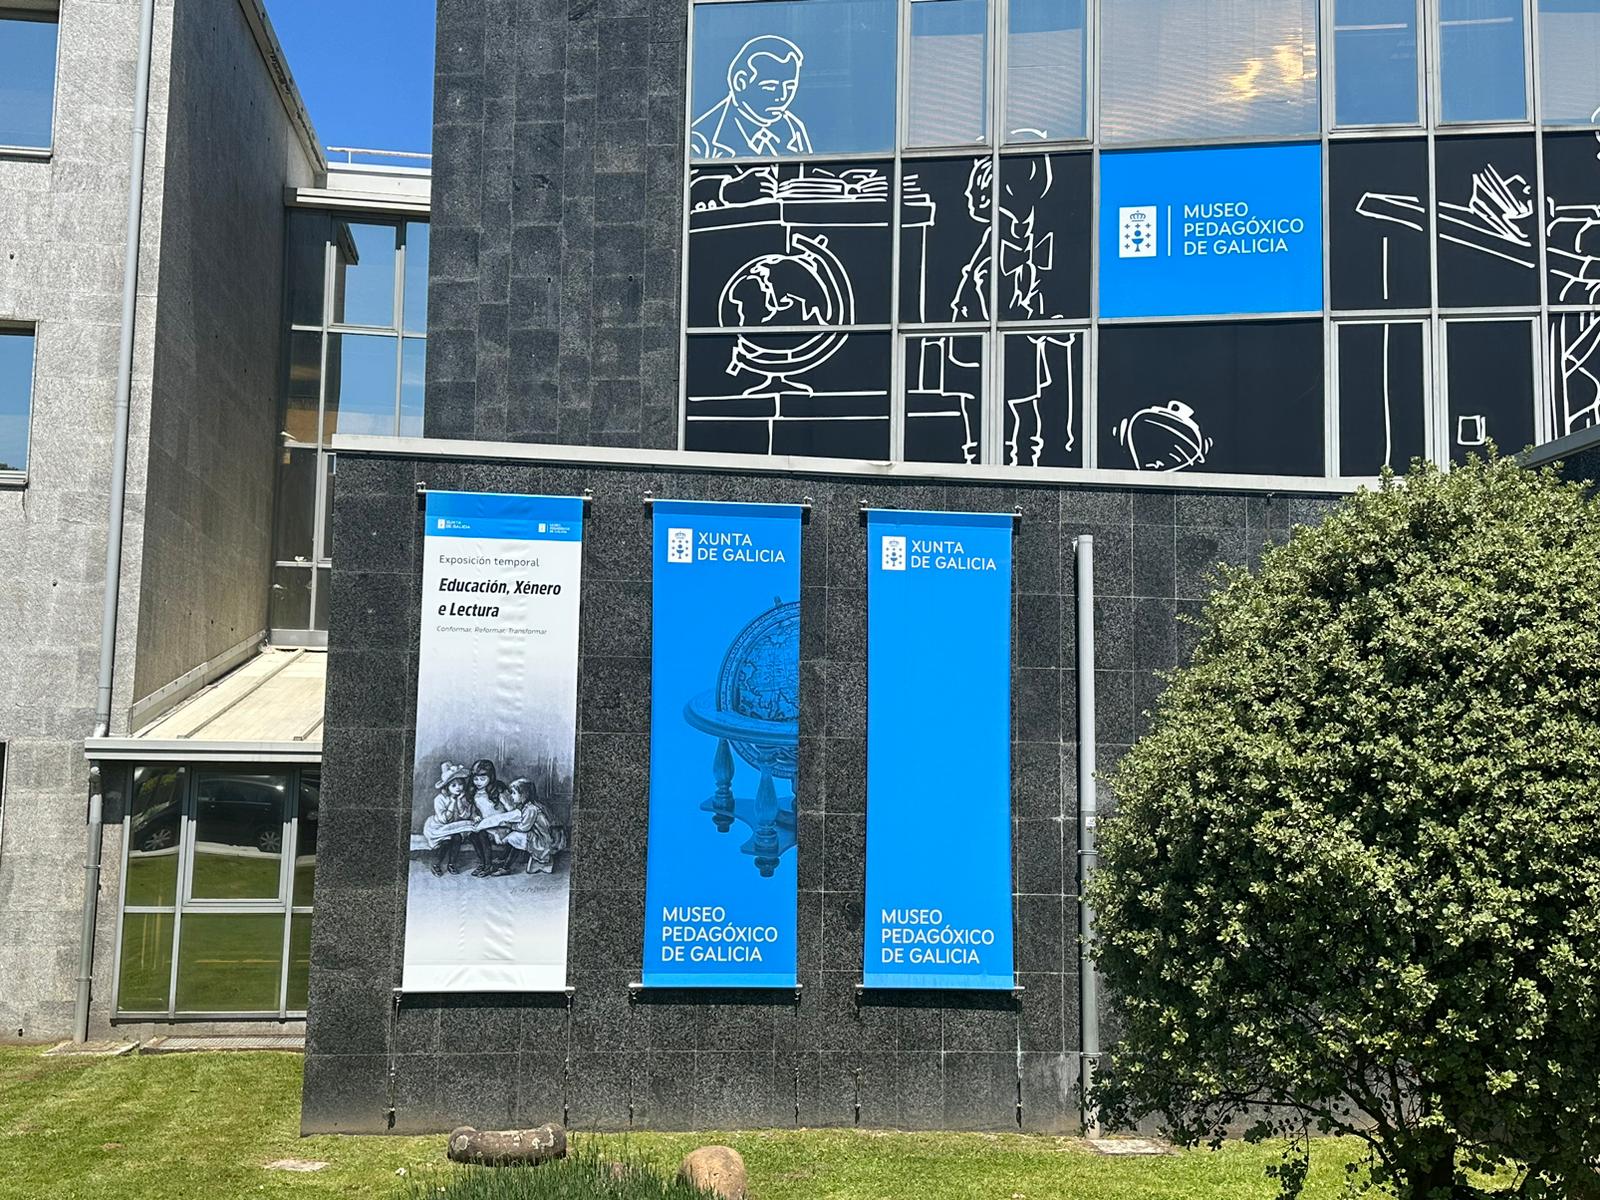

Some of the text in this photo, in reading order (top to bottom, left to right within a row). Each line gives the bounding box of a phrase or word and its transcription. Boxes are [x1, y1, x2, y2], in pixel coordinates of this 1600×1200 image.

[1184, 202, 1248, 219] MUSEO
[1184, 216, 1304, 237] PEDAGÓXICO
[1184, 238, 1289, 256] DE GALICIA
[698, 532, 753, 546] XUNTA
[911, 540, 965, 554] XUNTA
[439, 555, 540, 568] Exposición temporal
[697, 547, 786, 563] DE GALICIA
[911, 555, 997, 571] DE GALICIA
[438, 577, 562, 595] Educación, Xénero
[438, 602, 500, 617] e Lectura
[508, 627, 548, 636] Transformar
[662, 906, 726, 922] MUSEO
[881, 909, 943, 925] MUSEO
[662, 922, 778, 942] PEDAGÓXICO
[881, 924, 995, 945] PEDAGÓXICO
[661, 946, 763, 962] DE GALICIA
[881, 948, 980, 964] DE GALICIA
